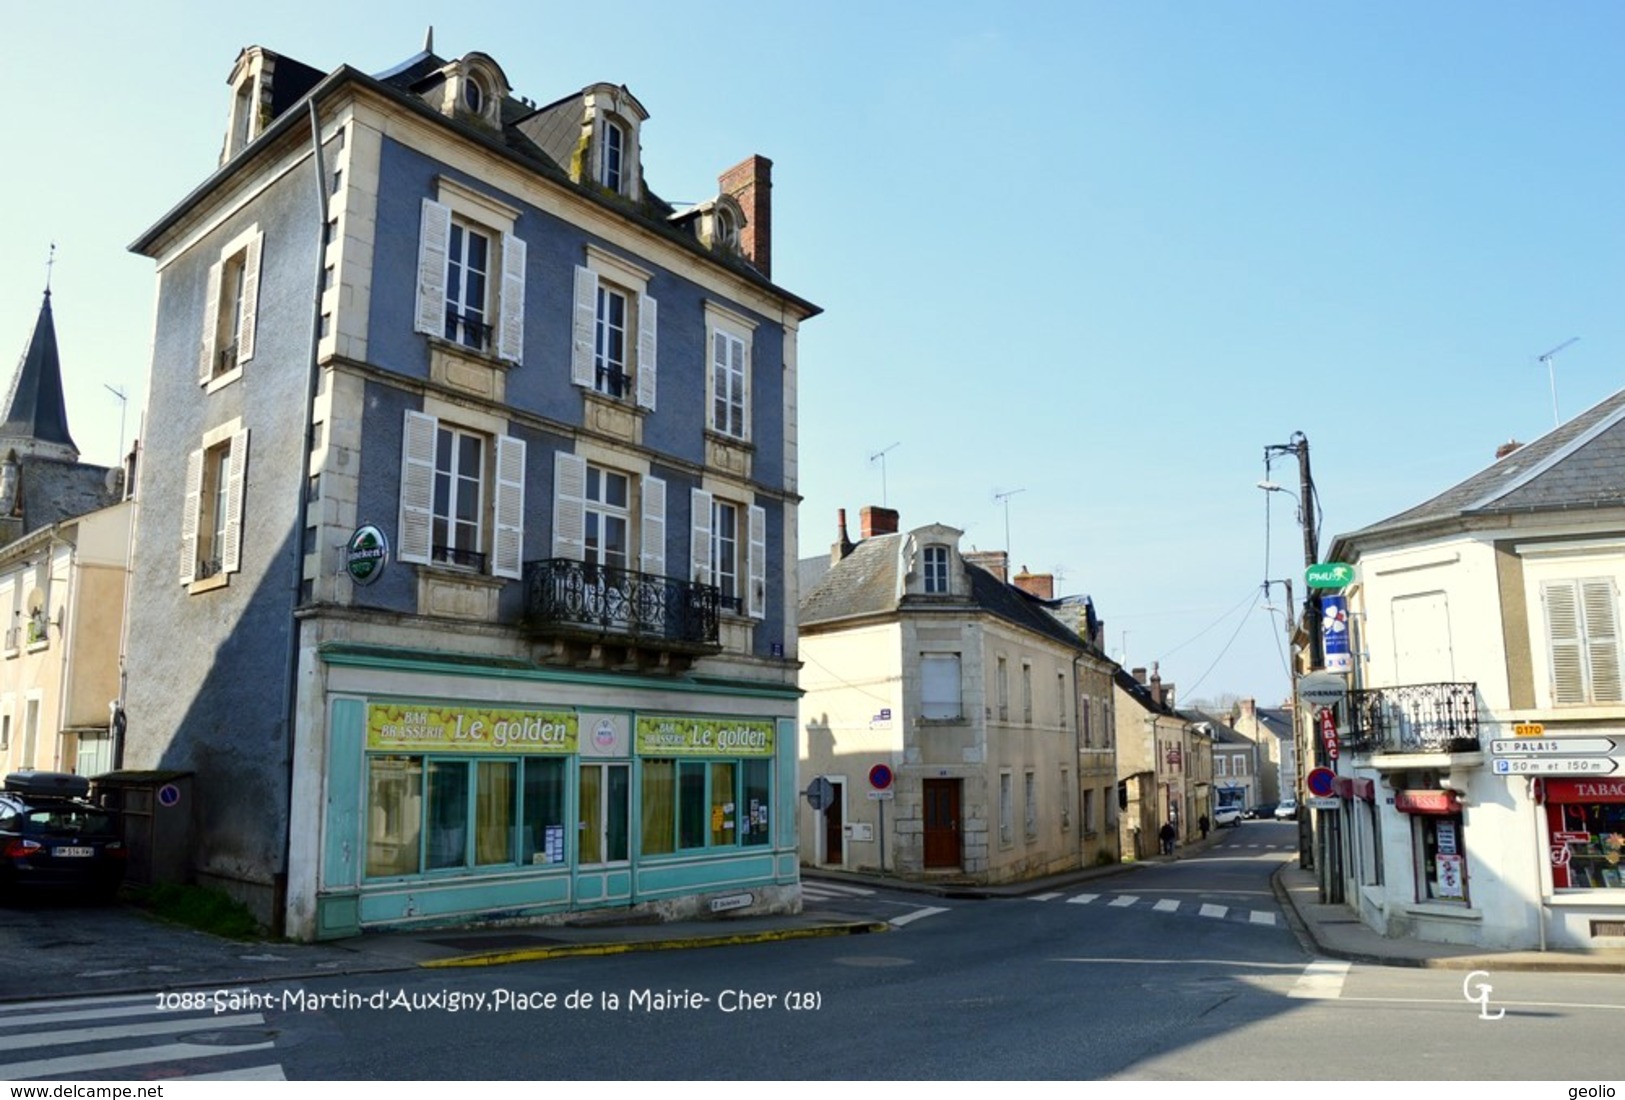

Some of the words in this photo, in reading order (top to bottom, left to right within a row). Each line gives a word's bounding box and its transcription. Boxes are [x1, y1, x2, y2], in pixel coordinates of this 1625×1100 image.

[1309, 572, 1332, 581] PMU
[404, 711, 427, 724] BAR
[381, 725, 444, 739] BRASSERIE
[455, 714, 483, 739] Le
[494, 717, 566, 747] golden
[659, 722, 675, 734] BAR
[1321, 709, 1338, 758] TABAC
[1515, 726, 1542, 735] D170
[692, 724, 711, 744] Le
[718, 727, 766, 751] golden
[1514, 742, 1558, 751] PALAIS
[1548, 762, 1559, 770] et
